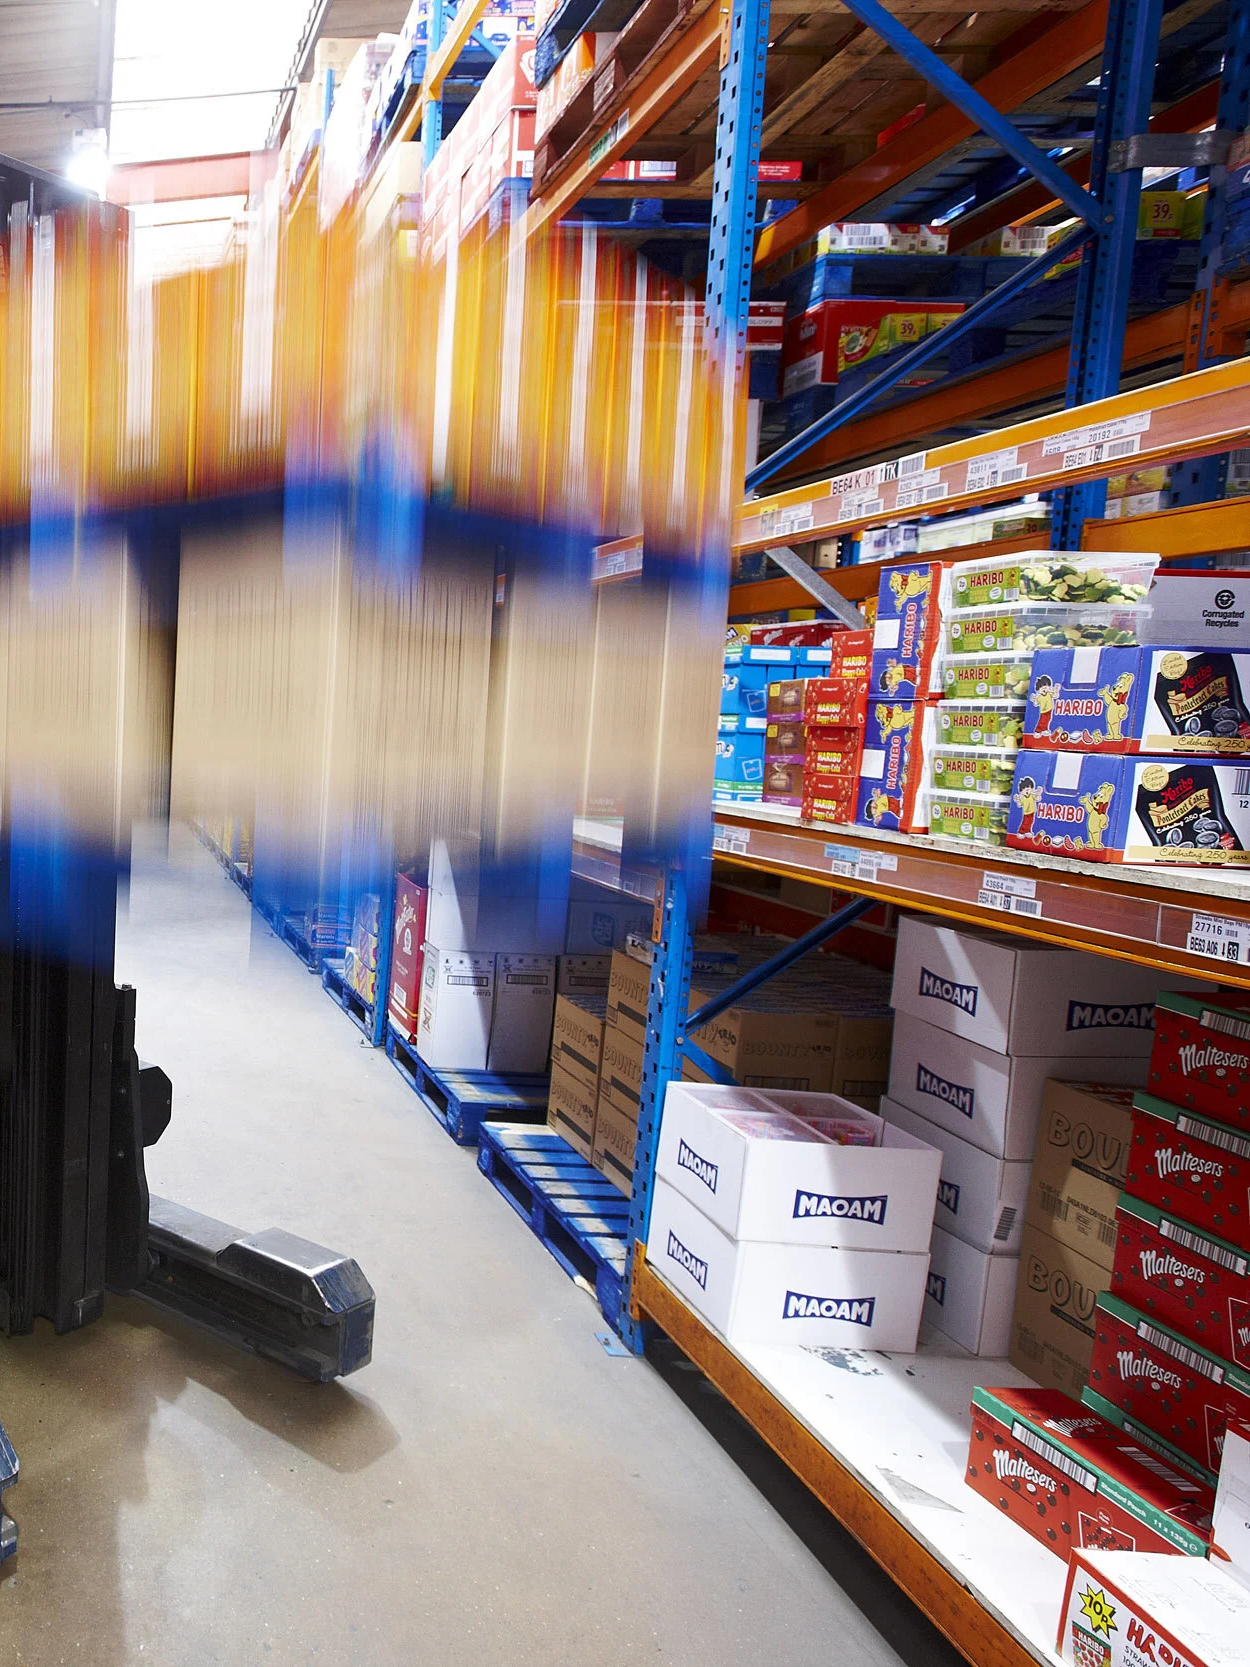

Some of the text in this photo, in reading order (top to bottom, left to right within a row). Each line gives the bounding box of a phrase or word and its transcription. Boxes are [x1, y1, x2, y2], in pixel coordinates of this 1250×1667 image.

[1089, 430, 1111, 442] 20192
[833, 478, 852, 494] BE64
[855, 476, 861, 488] K
[865, 472, 875, 486] 01
[970, 572, 1004, 588] HARIBO
[1202, 609, 1244, 620] Corrugated
[1205, 618, 1238, 628] Recycles
[902, 602, 918, 658] HARIBO
[964, 620, 996, 634] HARIBO
[958, 668, 990, 681] HARIBO
[1180, 666, 1212, 691] Haribo
[1054, 698, 1103, 717] HARIBO
[1175, 681, 1225, 713] Pontefract Cakes
[953, 714, 984, 728] HARIBO
[1178, 737, 1244, 749] Celebrating 250
[887, 736, 902, 790] HARIBO
[946, 760, 976, 773] HARIBO
[1161, 778, 1194, 803] Haribo
[944, 806, 974, 820] HARIBO
[1037, 803, 1084, 824] HARIBO
[1157, 792, 1206, 826] Pontefract Cakes
[1160, 848, 1248, 864] Celebrating 250 years
[1195, 922, 1222, 936] 27716
[1190, 936, 1238, 960] BE63 A06 33
[922, 972, 976, 1012] MAOAM
[1072, 1006, 1156, 1026] MAOAM
[1178, 1044, 1250, 1076] Maltesers
[919, 1070, 973, 1114] MAOAM
[680, 1144, 716, 1190] MAOAM
[1154, 1148, 1224, 1179] Maltesers
[798, 1194, 882, 1221] MAOAM
[669, 1235, 707, 1286] MAOAM
[1140, 1250, 1206, 1284] Maltesers
[786, 1296, 872, 1324] MAOAM
[1117, 1351, 1182, 1389] Maltesers
[993, 1449, 1058, 1492] Maltesers
